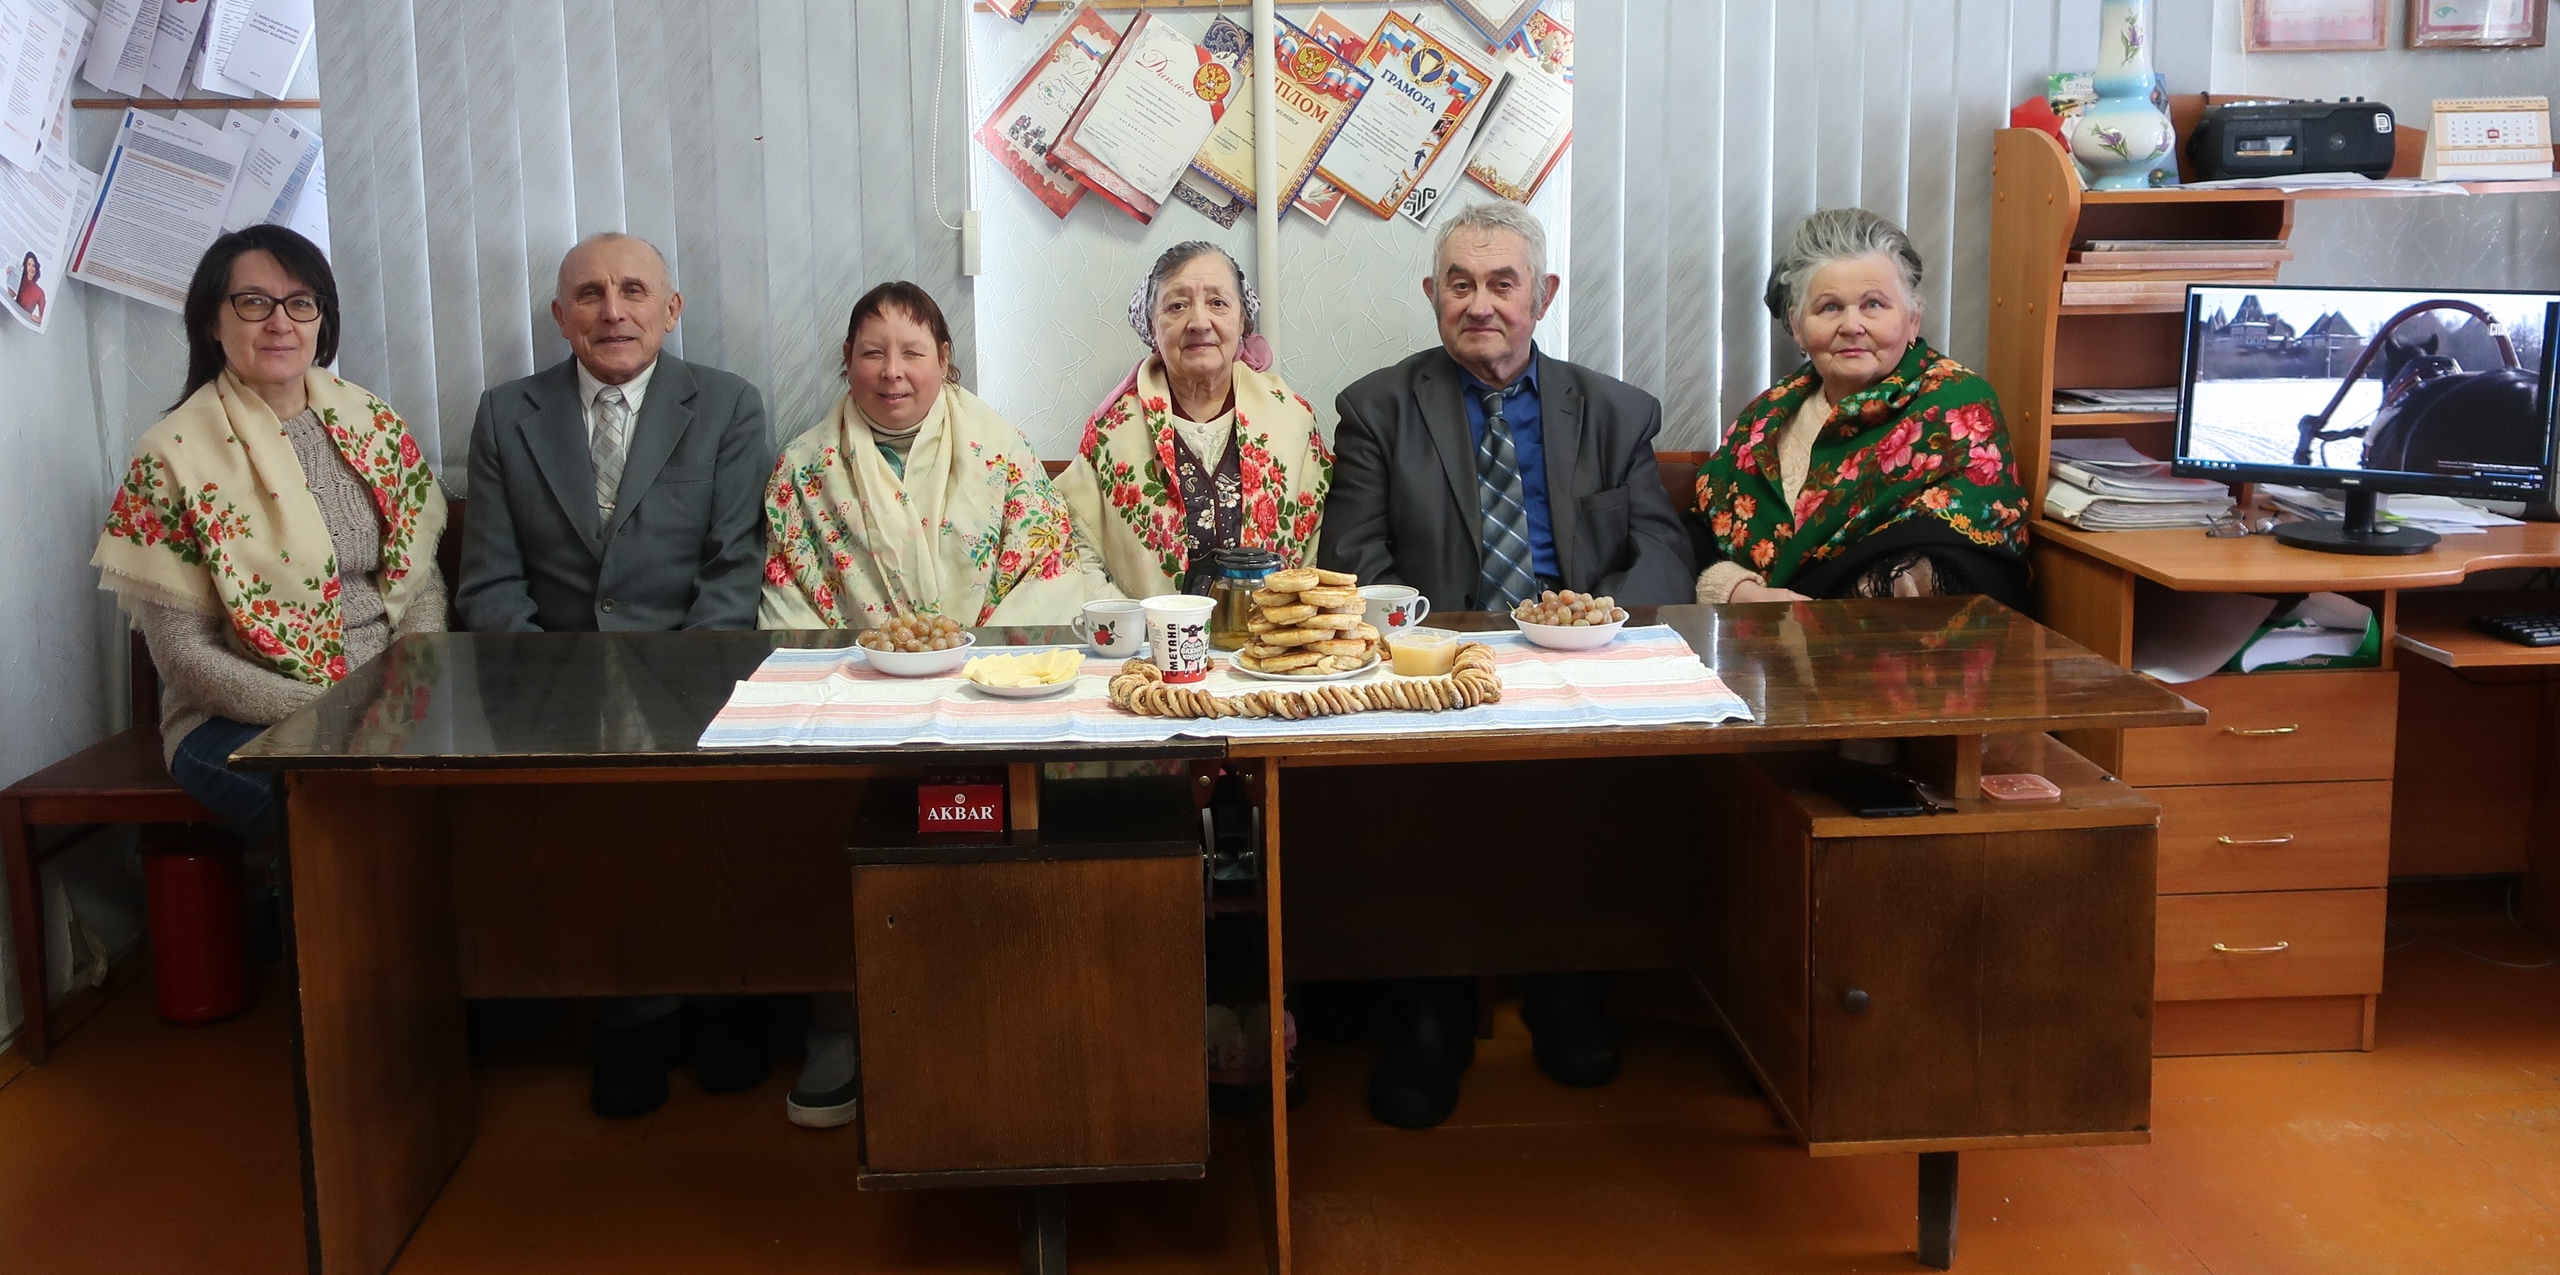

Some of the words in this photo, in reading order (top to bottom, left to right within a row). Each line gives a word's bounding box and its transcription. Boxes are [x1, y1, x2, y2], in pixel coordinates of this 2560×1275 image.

[1135, 49, 1194, 97] Диплом
[1380, 68, 1436, 114] ГРАМОТА
[1272, 76, 1329, 124] ПЛОМ
[1167, 623, 1179, 677] СМЕТАНА
[927, 806, 994, 820] AKBAR
